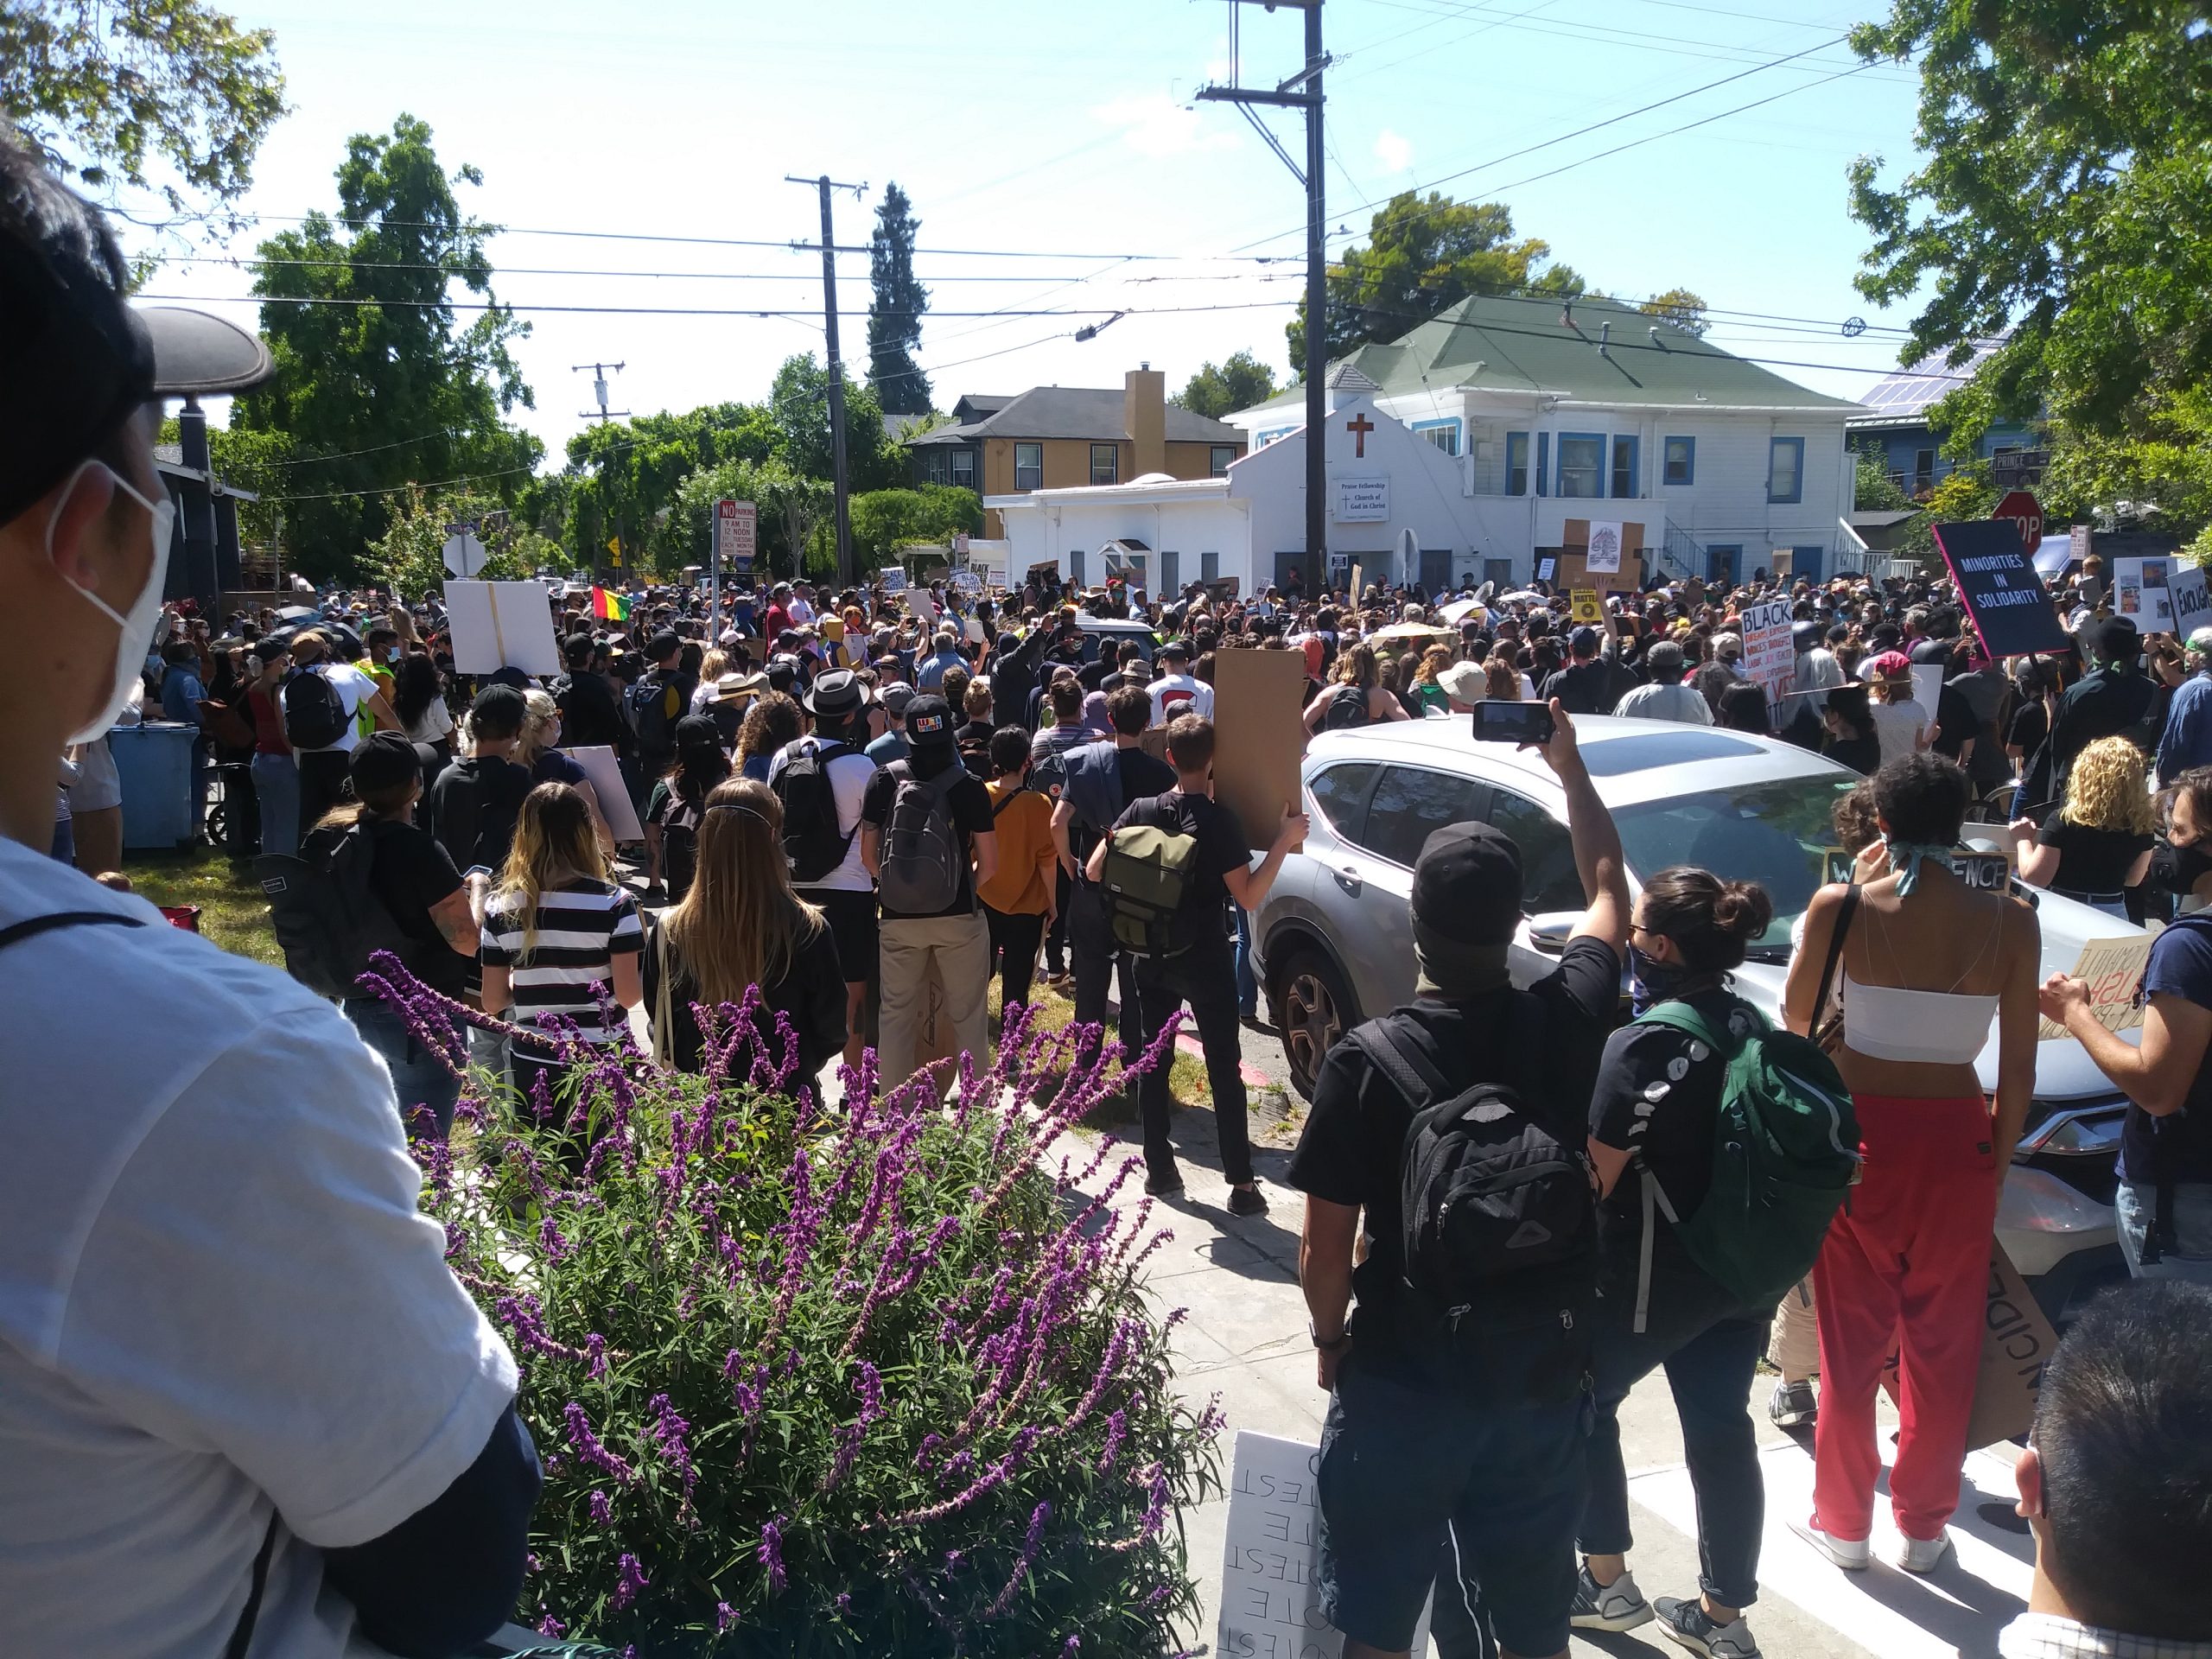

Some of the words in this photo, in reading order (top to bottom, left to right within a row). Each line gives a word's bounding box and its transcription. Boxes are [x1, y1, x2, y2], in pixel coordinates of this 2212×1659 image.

[1997, 454, 2025, 468] PRINCE
[722, 505, 734, 517] NO
[970, 563, 989, 574] BLACK
[1961, 554, 2024, 573] MINORITIES
[1993, 573, 2008, 588] IN
[1976, 589, 2039, 608] SOLIDARITY
[1743, 602, 1791, 633] BLACK
[1244, 1587, 1335, 1632] OTE
